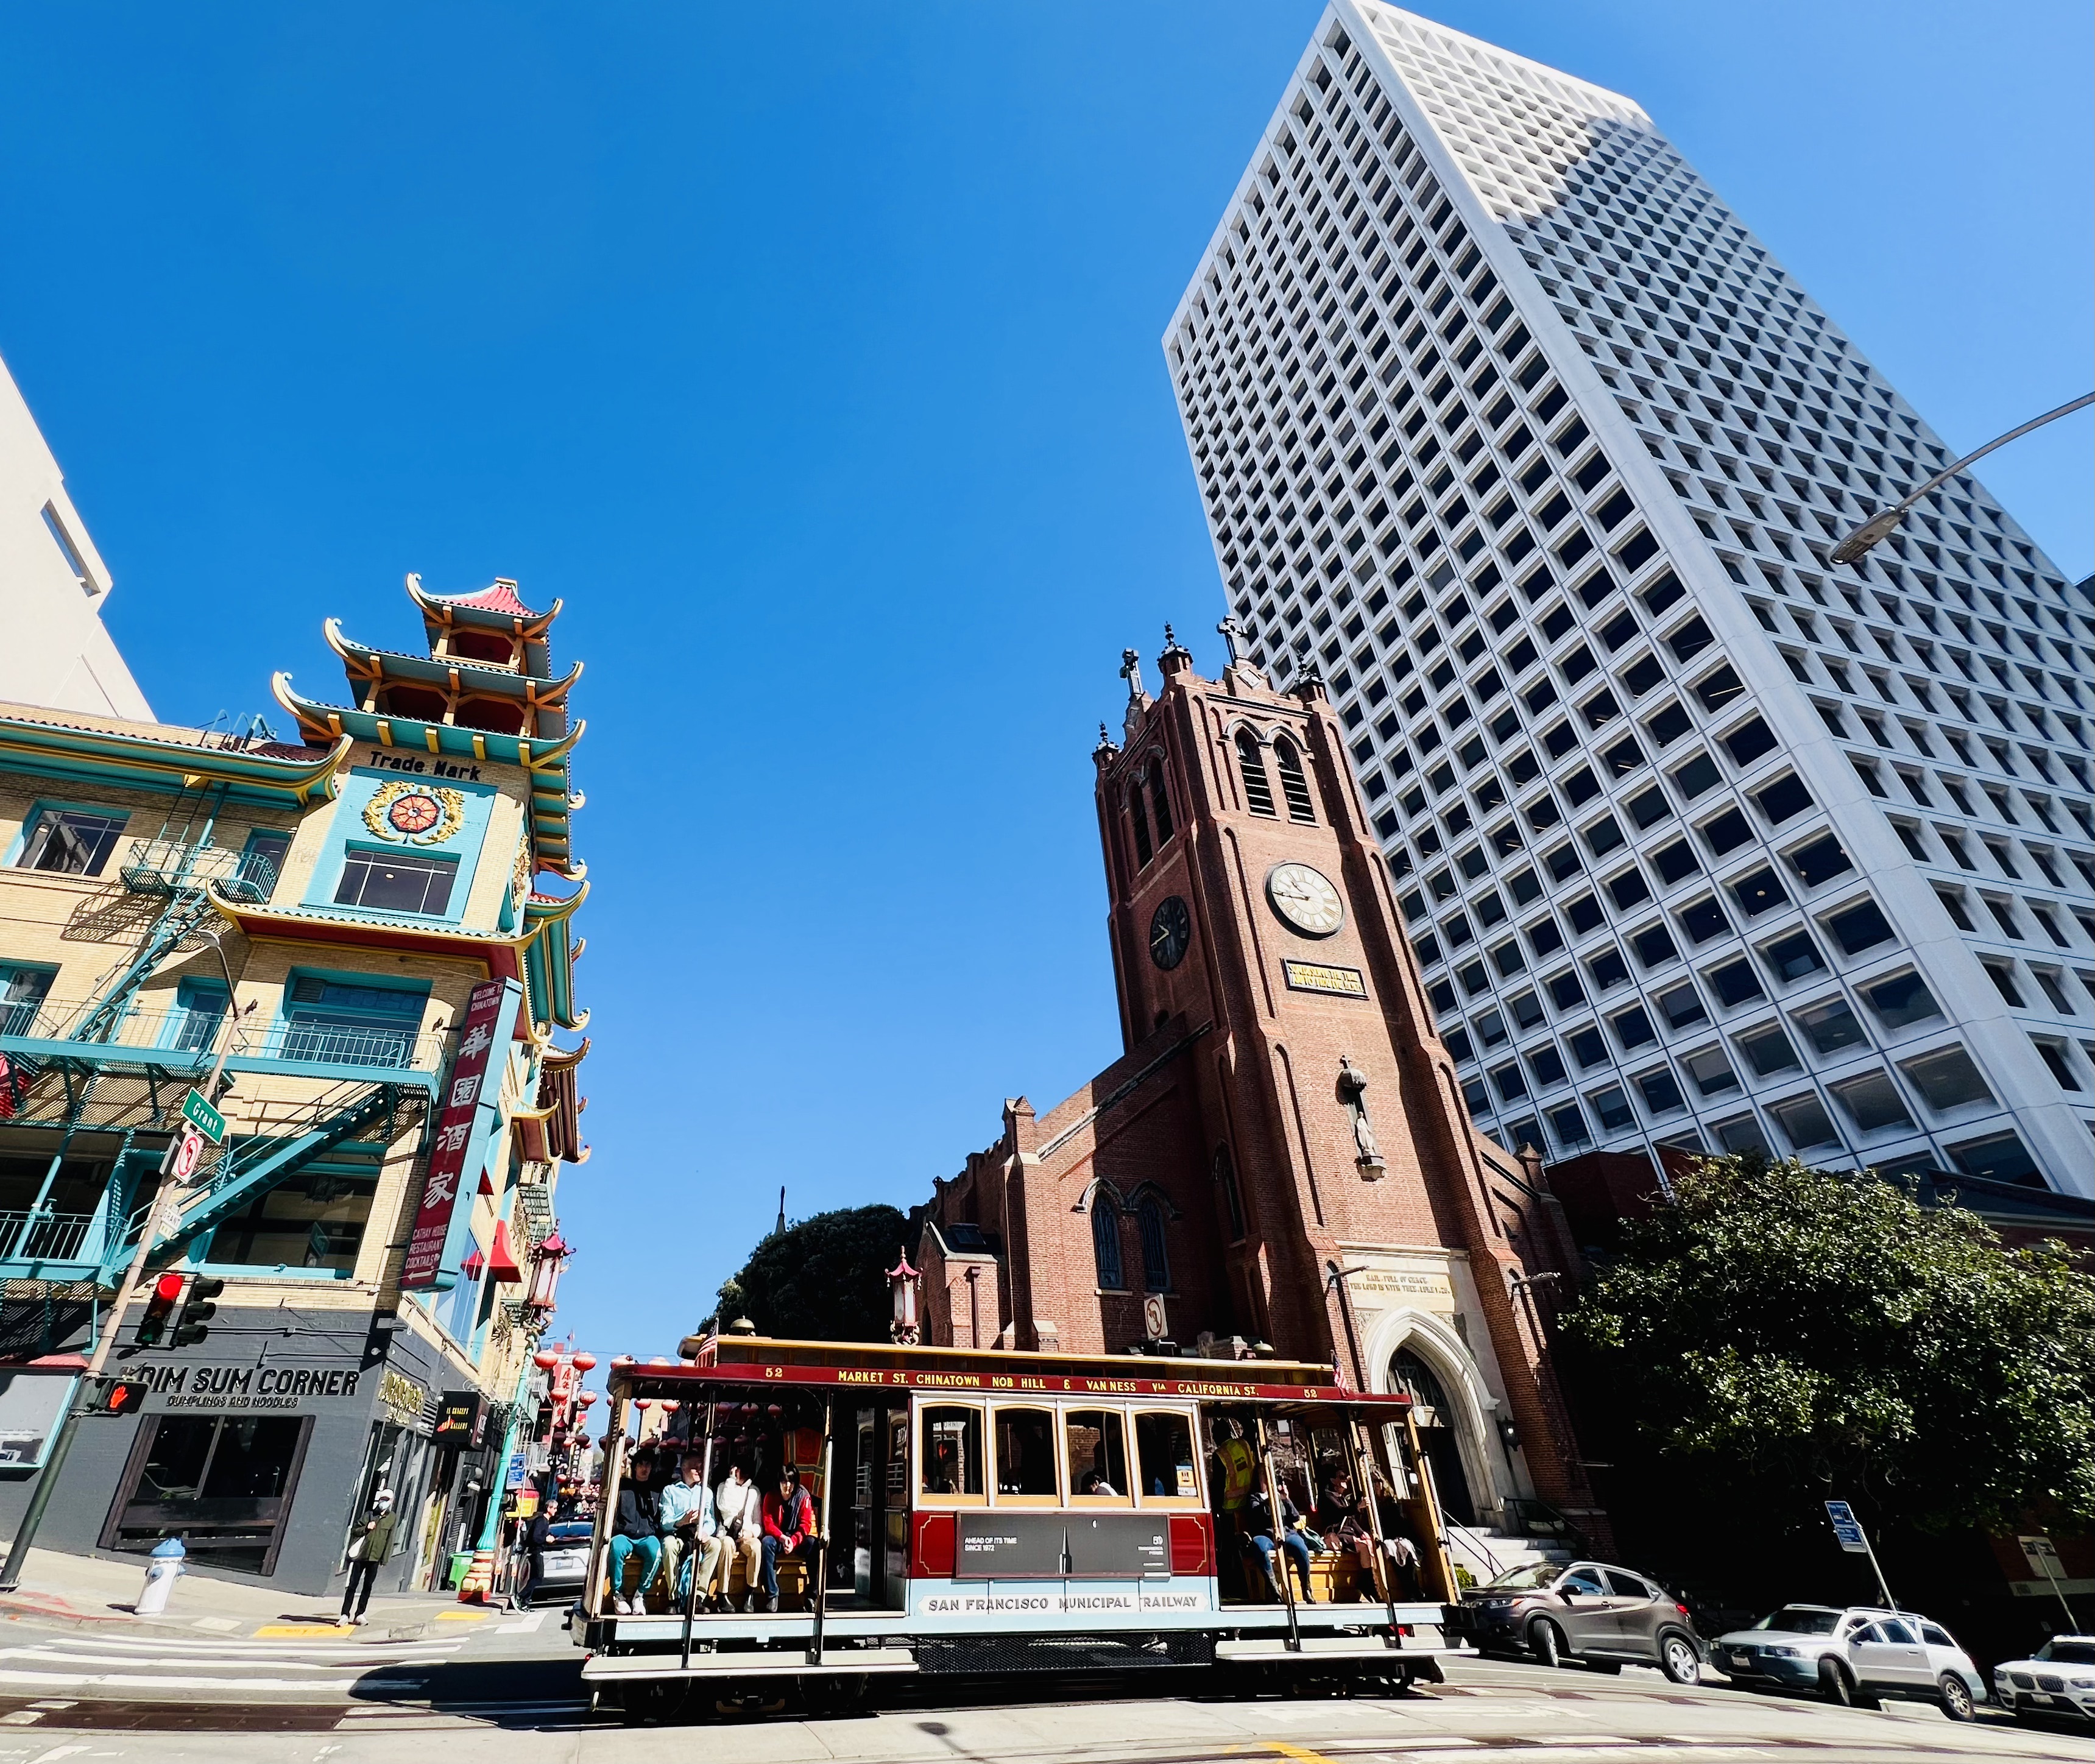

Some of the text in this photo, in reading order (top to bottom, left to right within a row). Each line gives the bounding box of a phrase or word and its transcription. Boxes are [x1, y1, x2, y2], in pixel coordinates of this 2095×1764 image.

[370, 750, 481, 781] Trade Mark
[473, 984, 503, 1001] WELCOME TO
[471, 995, 500, 1012] CHINATOWN
[193, 1102, 218, 1132] Grant
[412, 1224, 448, 1240] CATHAY HOUSE
[409, 1238, 445, 1254] RESTAURANT
[405, 1254, 434, 1269] COCKTAILS
[138, 1366, 189, 1393] DIM
[191, 1366, 253, 1394] SUM
[257, 1368, 360, 1396] CORNER
[765, 1367, 783, 1378] 52
[838, 1371, 884, 1383] MARKET
[892, 1373, 909, 1385] ST.
[916, 1374, 980, 1386] CHINATOWN
[992, 1376, 1014, 1388] NOB
[1021, 1378, 1046, 1389] HILL
[1086, 1380, 1106, 1391] VAN
[1110, 1381, 1136, 1392] NESS
[1178, 1383, 1241, 1395] CALIFORNIA
[1244, 1386, 1259, 1396] ST.
[1303, 1388, 1318, 1398] 52
[166, 1395, 298, 1409] DUMPLINGS AND NOODLES
[928, 1596, 1197, 1611] SAN FRANCISCO MUNICIPAL RAILWAY
